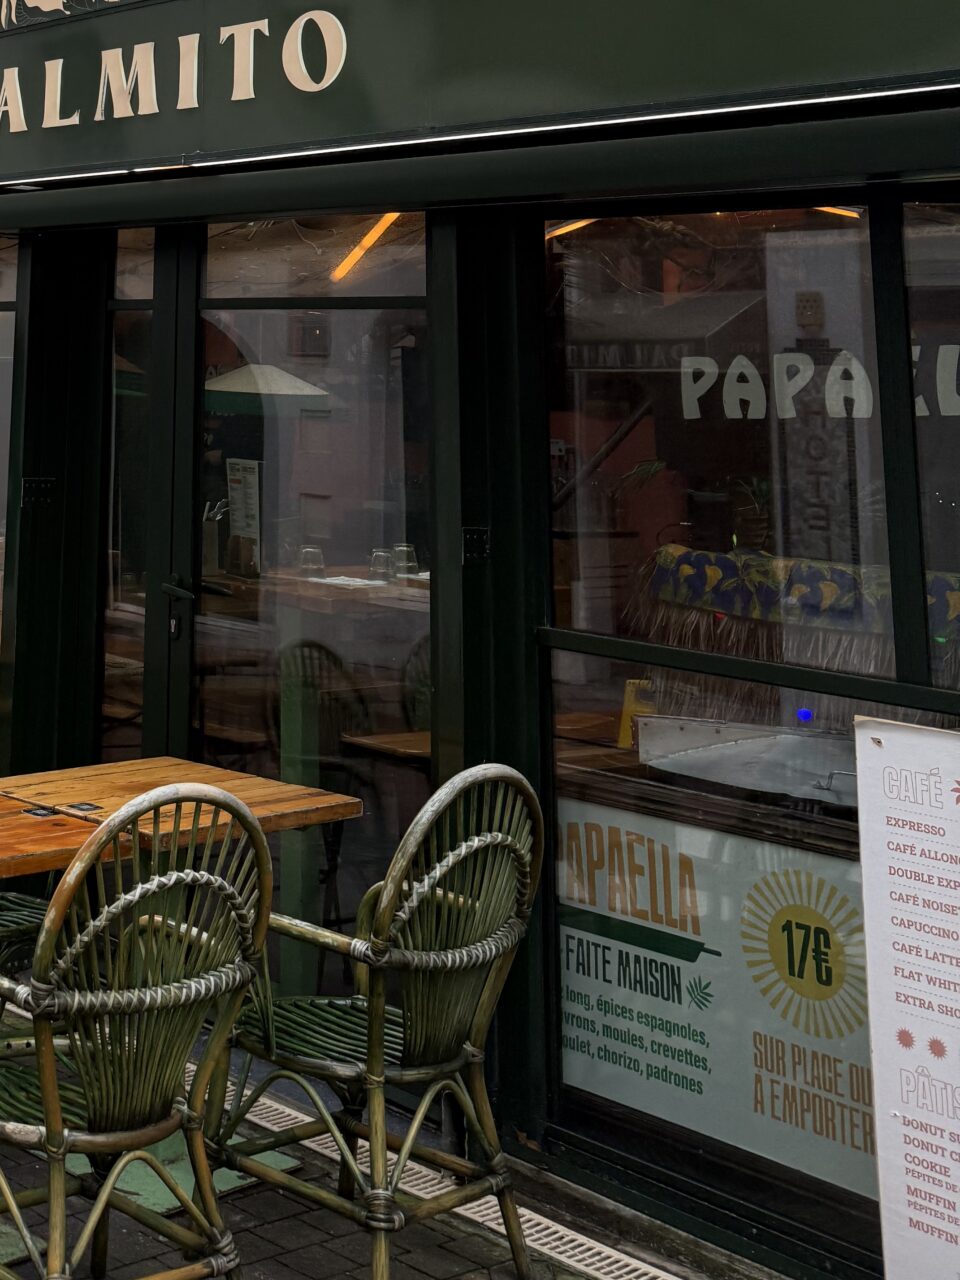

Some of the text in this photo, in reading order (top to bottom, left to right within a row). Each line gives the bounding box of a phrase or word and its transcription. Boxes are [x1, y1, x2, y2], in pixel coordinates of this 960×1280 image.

[882, 766, 944, 810] CAFÉ
[886, 816, 946, 838] EXPRESSO
[887, 840, 960, 866] CAFÉ ALLON
[888, 865, 935, 885] DOUBLE
[889, 890, 920, 907] CAFÉ
[891, 915, 959, 942] CAPUCCINO
[782, 920, 833, 987] 17€
[892, 940, 923, 958] CAFÉ
[565, 934, 682, 1005] FAITE MAISON
[894, 966, 960, 993] FLAT WHIT
[895, 991, 935, 1012] EXTRA
[566, 985, 710, 1049] long, épices espagnoles,
[602, 1024, 648, 1053] moules,
[650, 1039, 712, 1075] crevettes,
[597, 1045, 643, 1077] chorizo,
[646, 1062, 704, 1096] padrones
[753, 1031, 873, 1108] SUR PLACE OU
[769, 1078, 876, 1156] EMPORTER
[903, 1115, 946, 1140] DONUT
[904, 1133, 947, 1158] DONUT
[904, 1152, 951, 1179] COOKIE
[905, 1166, 959, 1194] PÉPITES DE
[906, 1184, 957, 1213] MUFFIN
[907, 1199, 960, 1227] PÉPITES DE
[908, 1216, 959, 1246] MUFFIN
